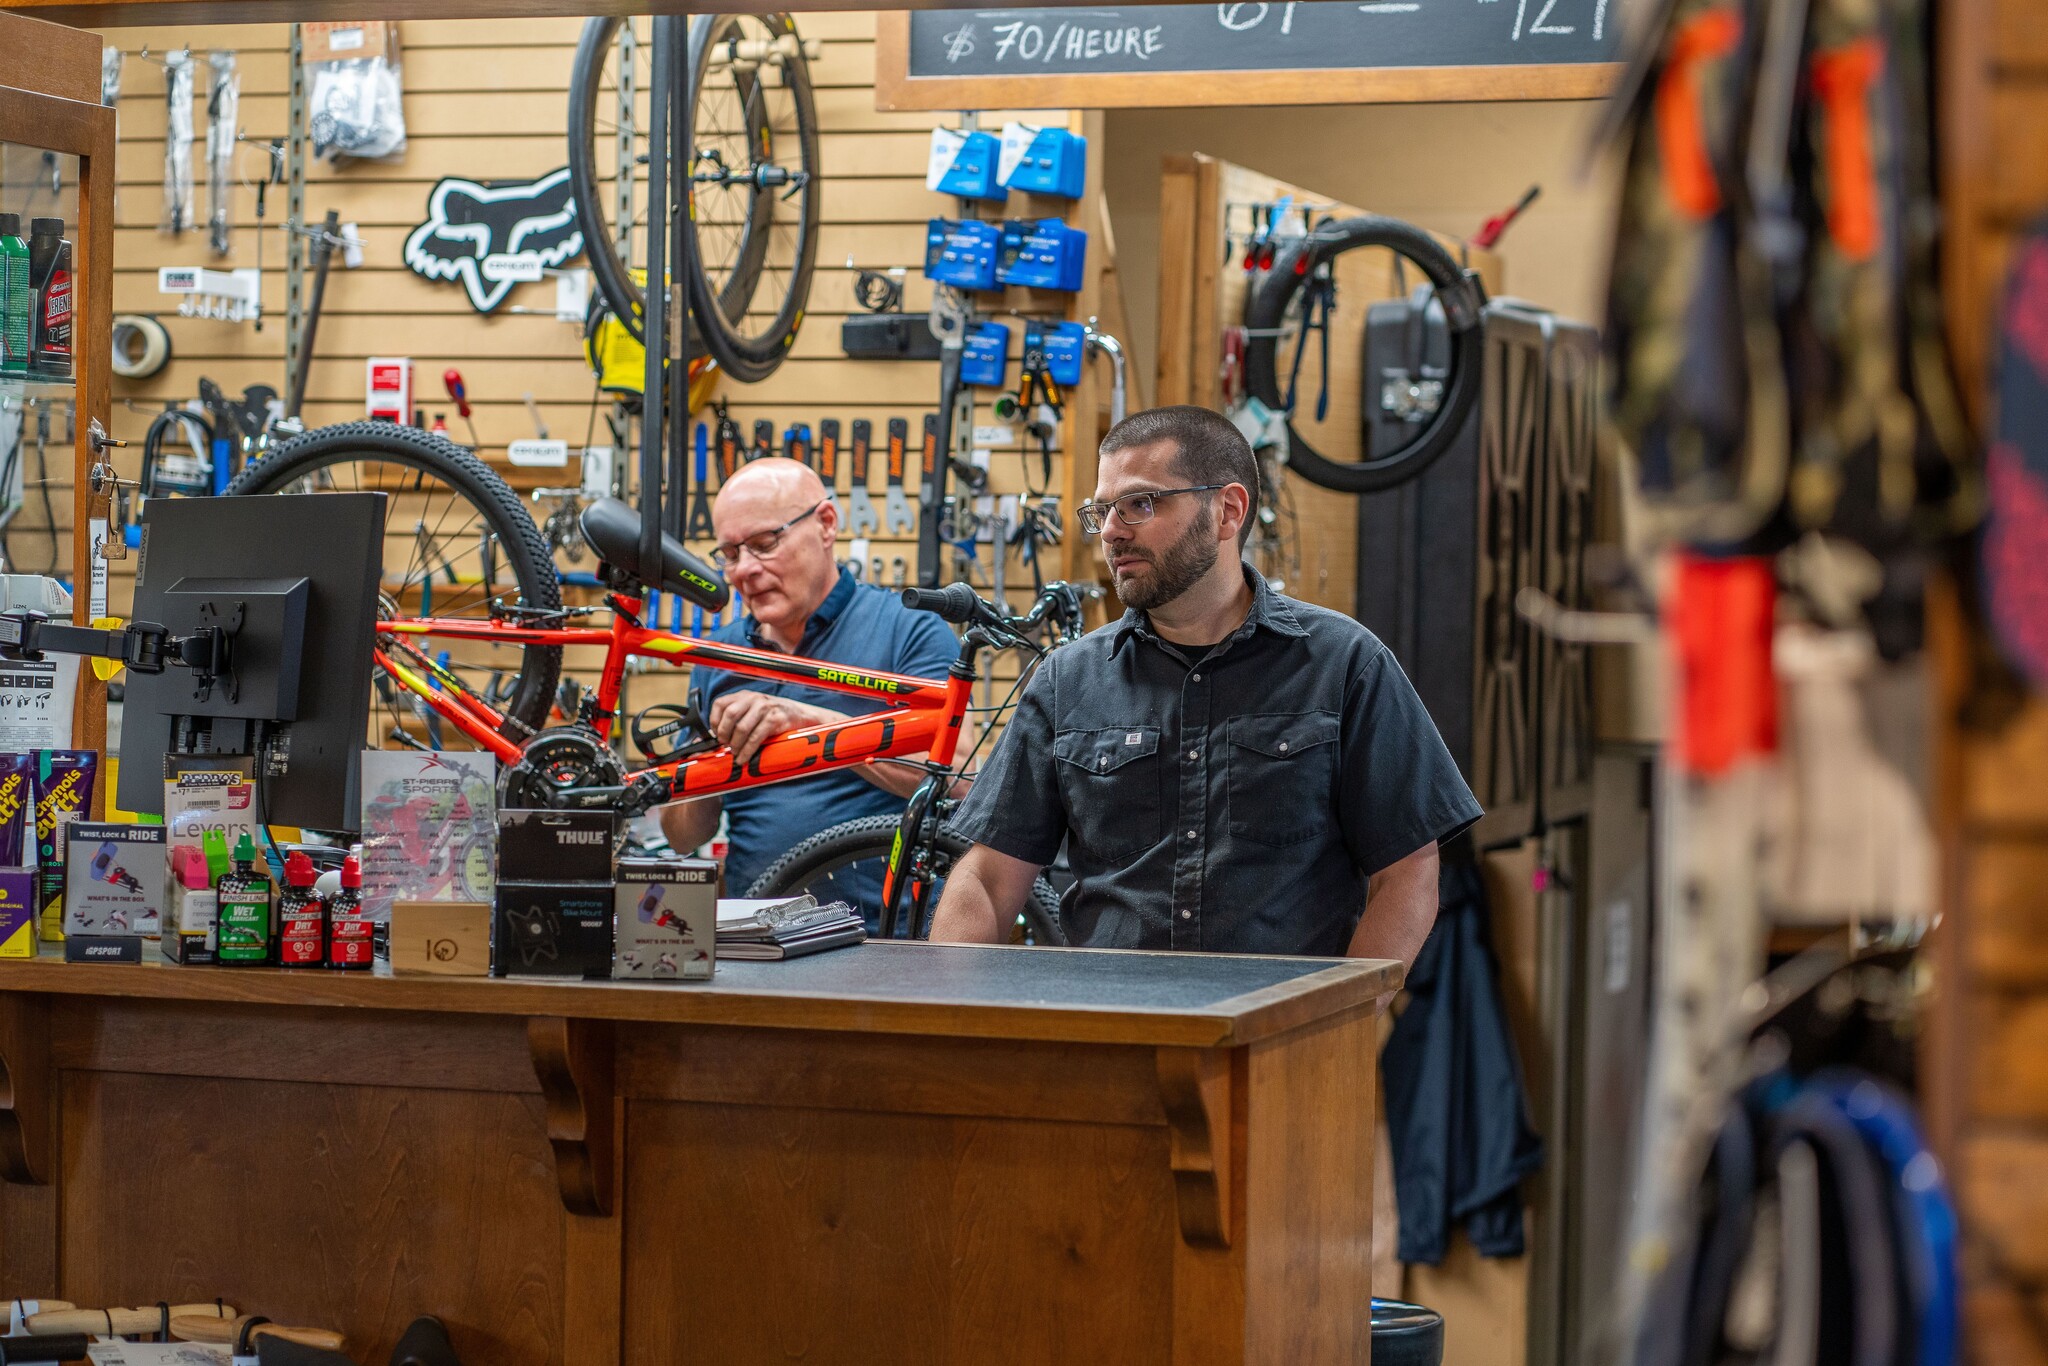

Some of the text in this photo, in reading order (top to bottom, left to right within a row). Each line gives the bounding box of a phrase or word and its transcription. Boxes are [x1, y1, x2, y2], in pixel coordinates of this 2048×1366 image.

[943, 21, 1165, 63] $ 70/HEURE
[137, 529, 147, 581] Lenovo
[818, 668, 899, 693] SATELLITE
[402, 786, 459, 794] SPORTS
[79, 831, 101, 839] TWIST,
[128, 830, 158, 841] RIDE
[173, 823, 249, 838] Levers
[556, 831, 605, 845] THULE
[625, 872, 648, 881] TWIST,
[675, 871, 707, 882] RIDE
[233, 905, 255, 915] WET
[559, 900, 603, 909] Smartphone
[294, 921, 312, 930] DRY
[343, 922, 361, 931] DRY
[85, 946, 122, 956] iGPSPORT
